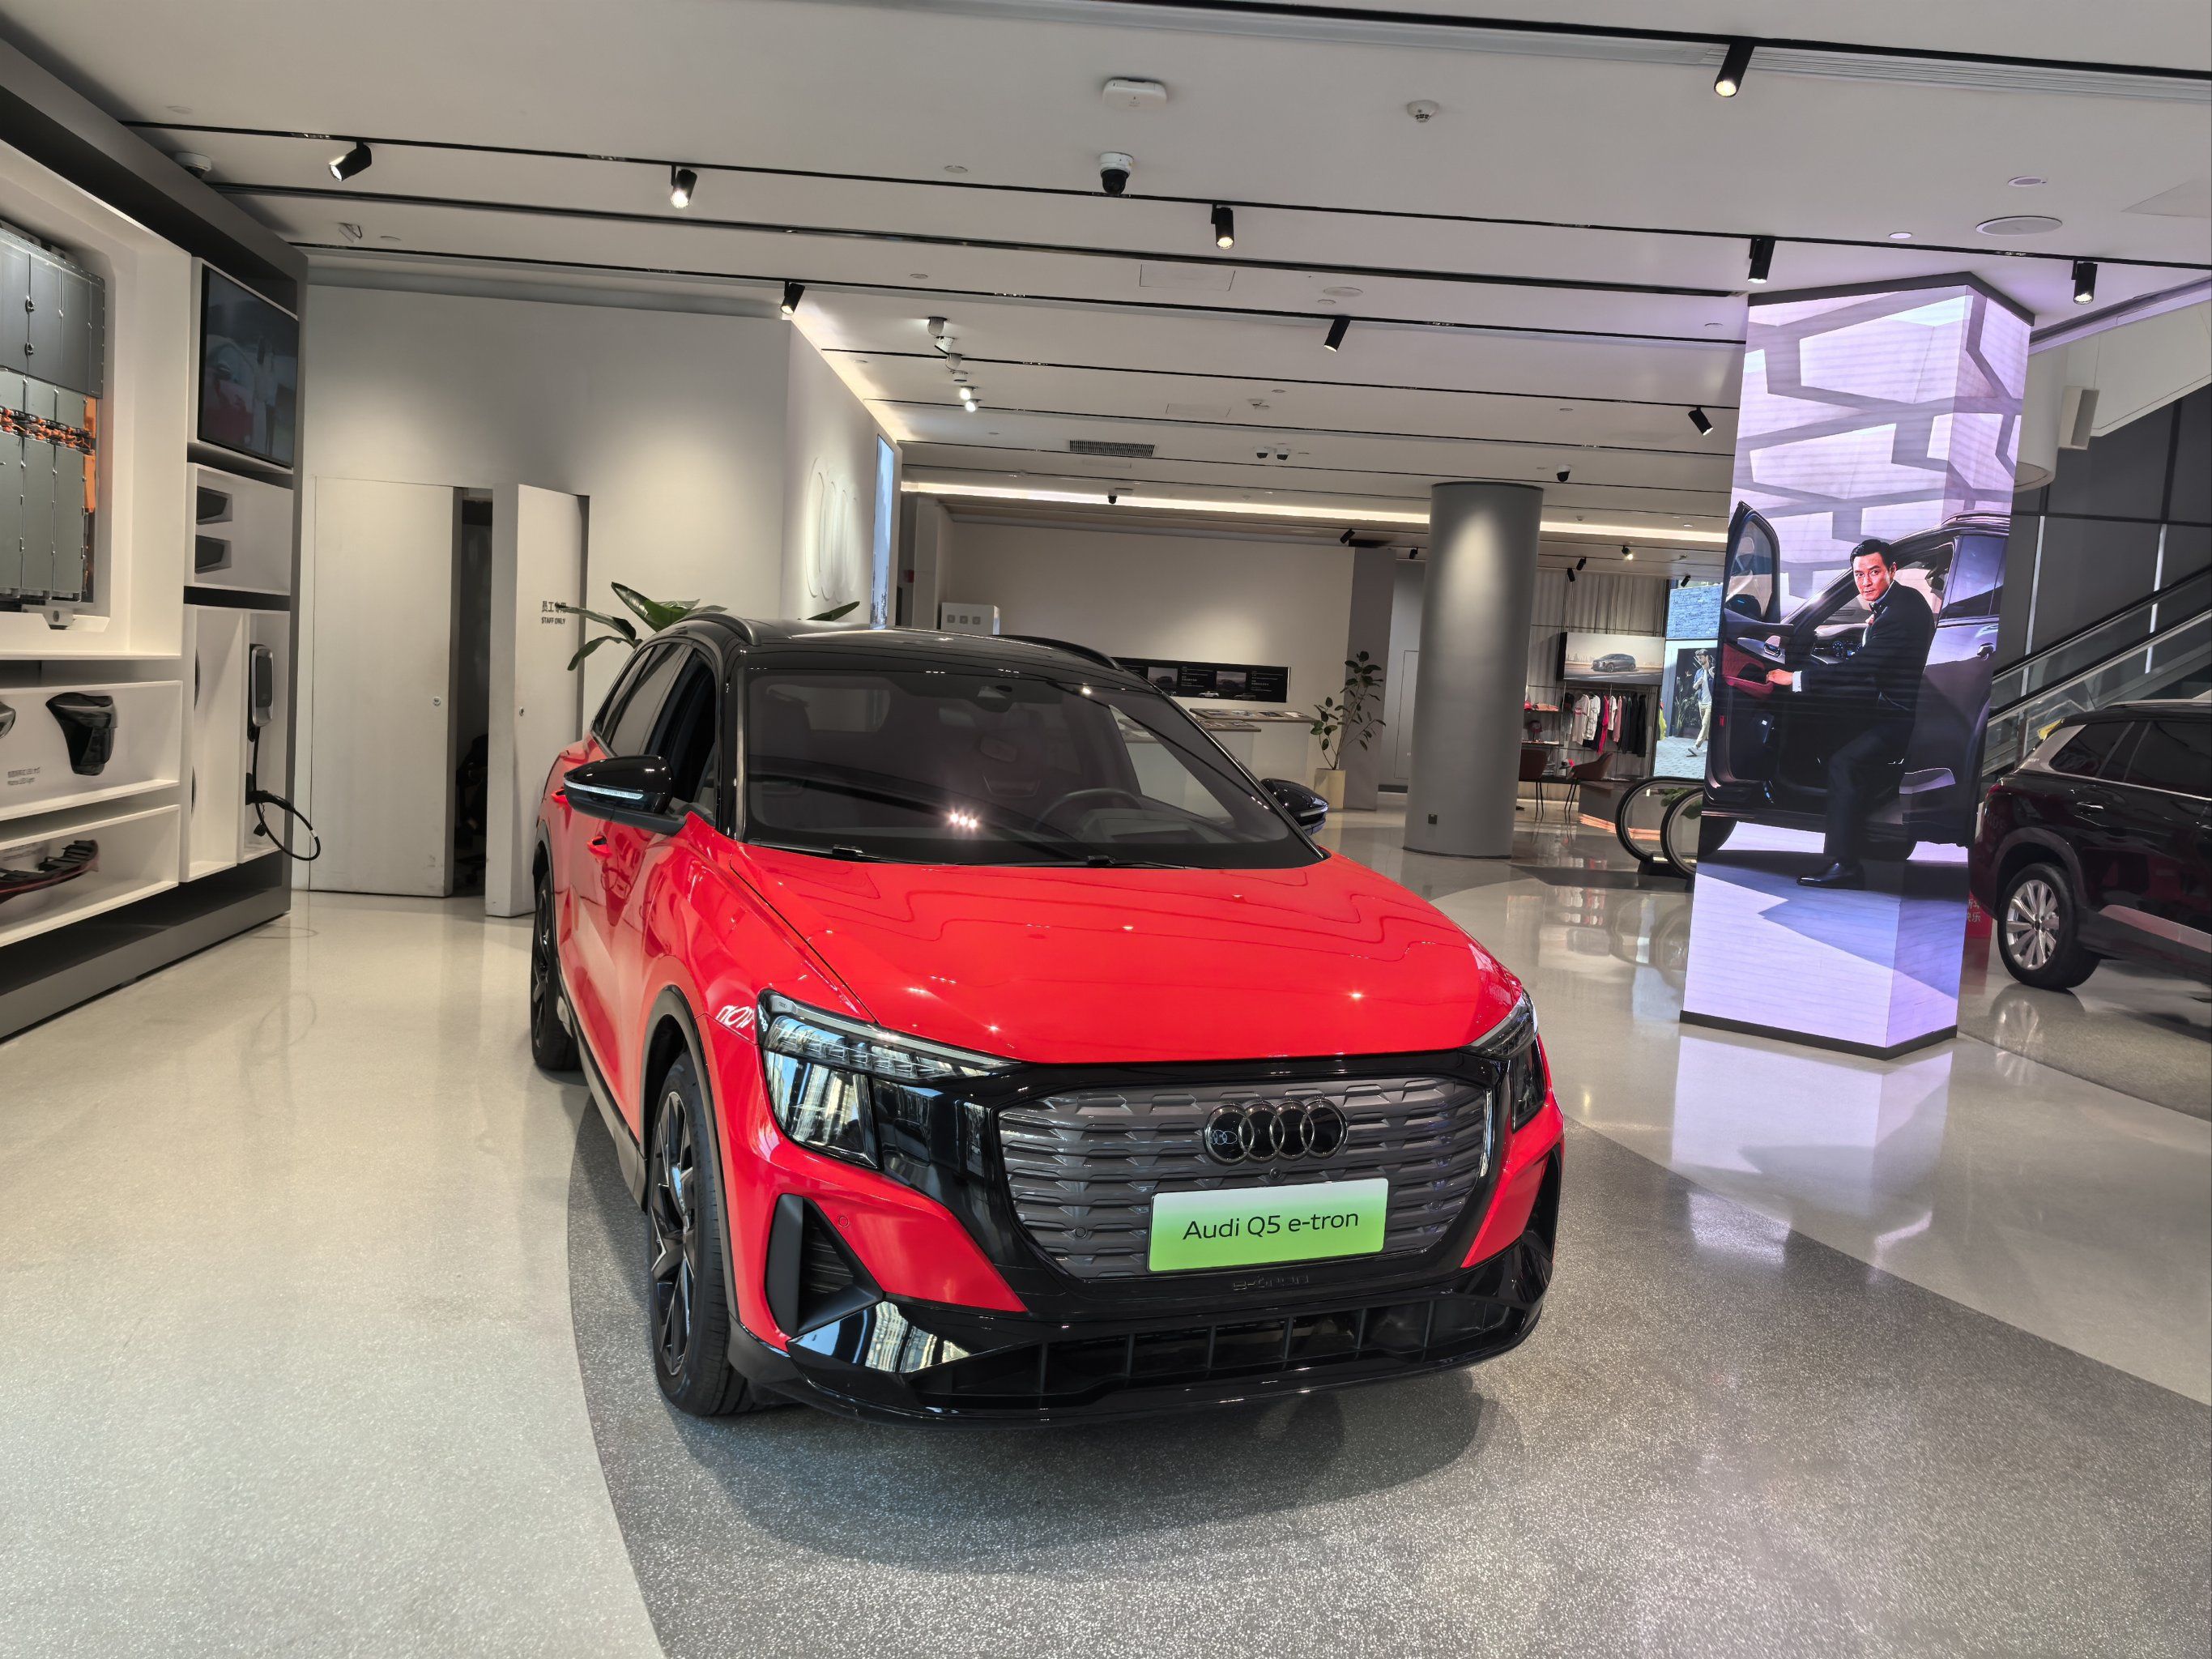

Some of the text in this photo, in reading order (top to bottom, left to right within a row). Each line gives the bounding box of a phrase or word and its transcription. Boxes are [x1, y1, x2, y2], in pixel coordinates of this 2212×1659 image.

[1183, 1213, 1359, 1240] Audi Q5 e-tron
